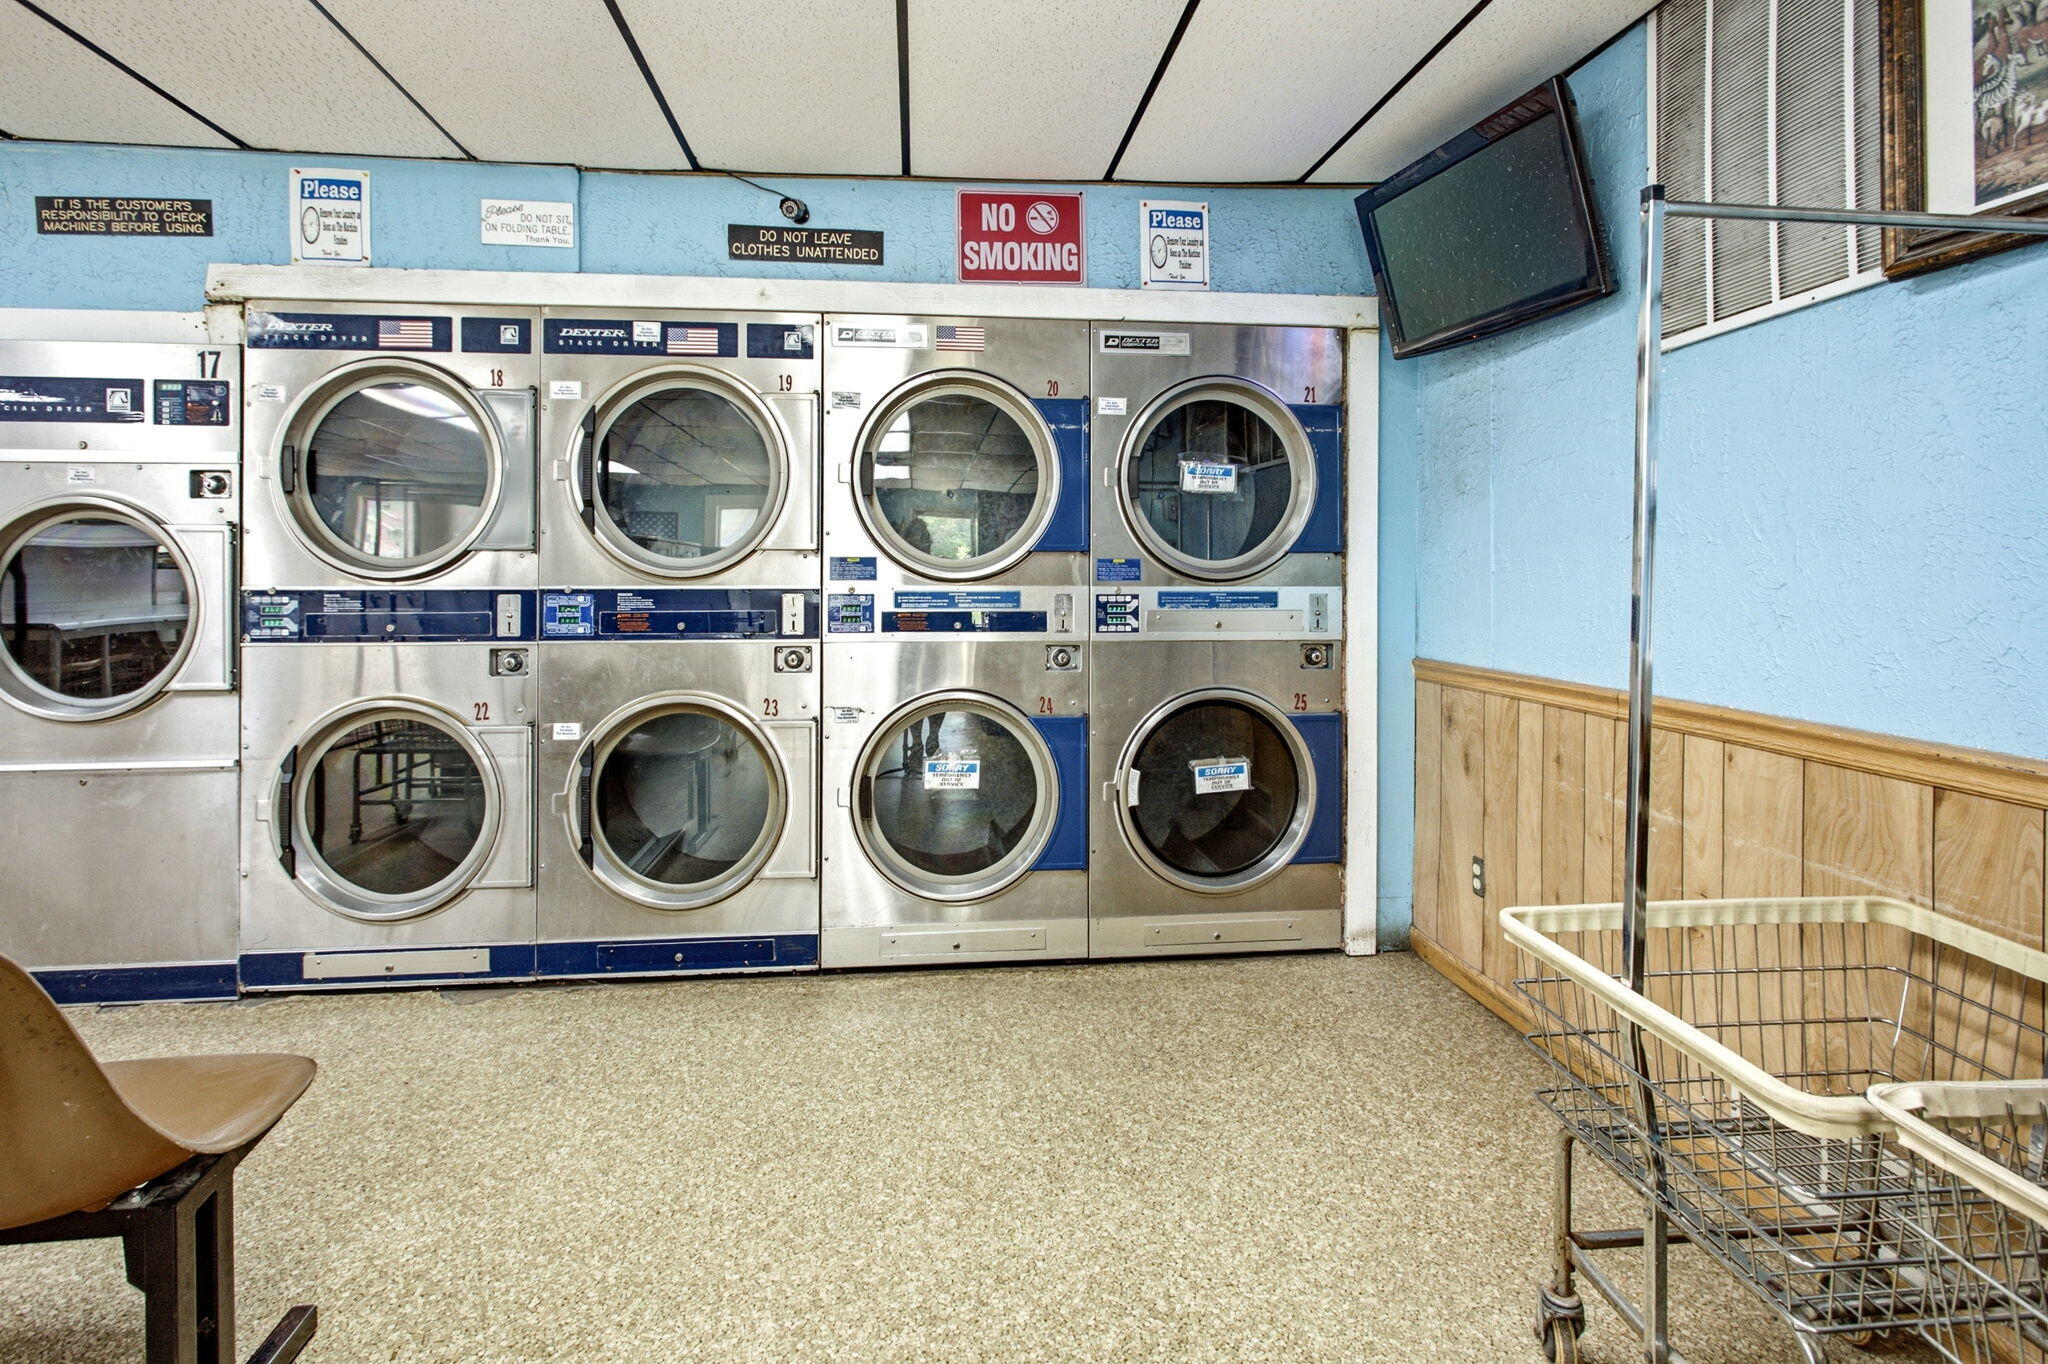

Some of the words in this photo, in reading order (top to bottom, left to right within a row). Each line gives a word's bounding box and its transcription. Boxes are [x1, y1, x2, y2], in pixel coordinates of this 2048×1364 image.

[302, 180, 360, 199] Please
[54, 199, 64, 209] IT
[69, 199, 81, 209] IS
[86, 199, 111, 210] THE
[115, 200, 192, 211] CUSTOMER'S
[484, 204, 524, 219] Please
[41, 210, 139, 221] RESPONSIBILITY
[142, 211, 158, 221] TO
[163, 212, 207, 223] CHECK
[520, 213, 533, 222] DO
[536, 214, 553, 223] NOT
[981, 203, 1015, 232] NO
[1151, 211, 1201, 228] Please
[43, 221, 106, 232] MACHINES
[111, 222, 161, 233] BEFORE
[485, 223, 498, 232] ON
[501, 223, 538, 234] FOLDING
[541, 225, 570, 235] TABLE.
[526, 235, 550, 243] Thank
[553, 236, 570, 244] You.
[760, 230, 776, 242] DO
[783, 231, 808, 243] NOT
[814, 233, 852, 245] LEAVE
[732, 243, 790, 257] CLOTHES
[797, 246, 879, 260] UNATTENDED
[964, 241, 1078, 271] SMOKING
[559, 328, 626, 337] DEXTER
[197, 350, 221, 379] 17
[490, 369, 504, 386] 18
[778, 374, 792, 392] 19
[1047, 380, 1059, 397] 20
[1304, 386, 1317, 403] 21
[763, 698, 779, 717] 23
[1039, 697, 1053, 715] 24
[1294, 693, 1308, 711] 25
[474, 702, 490, 722] 22
[1204, 766, 1237, 776] SORRY
